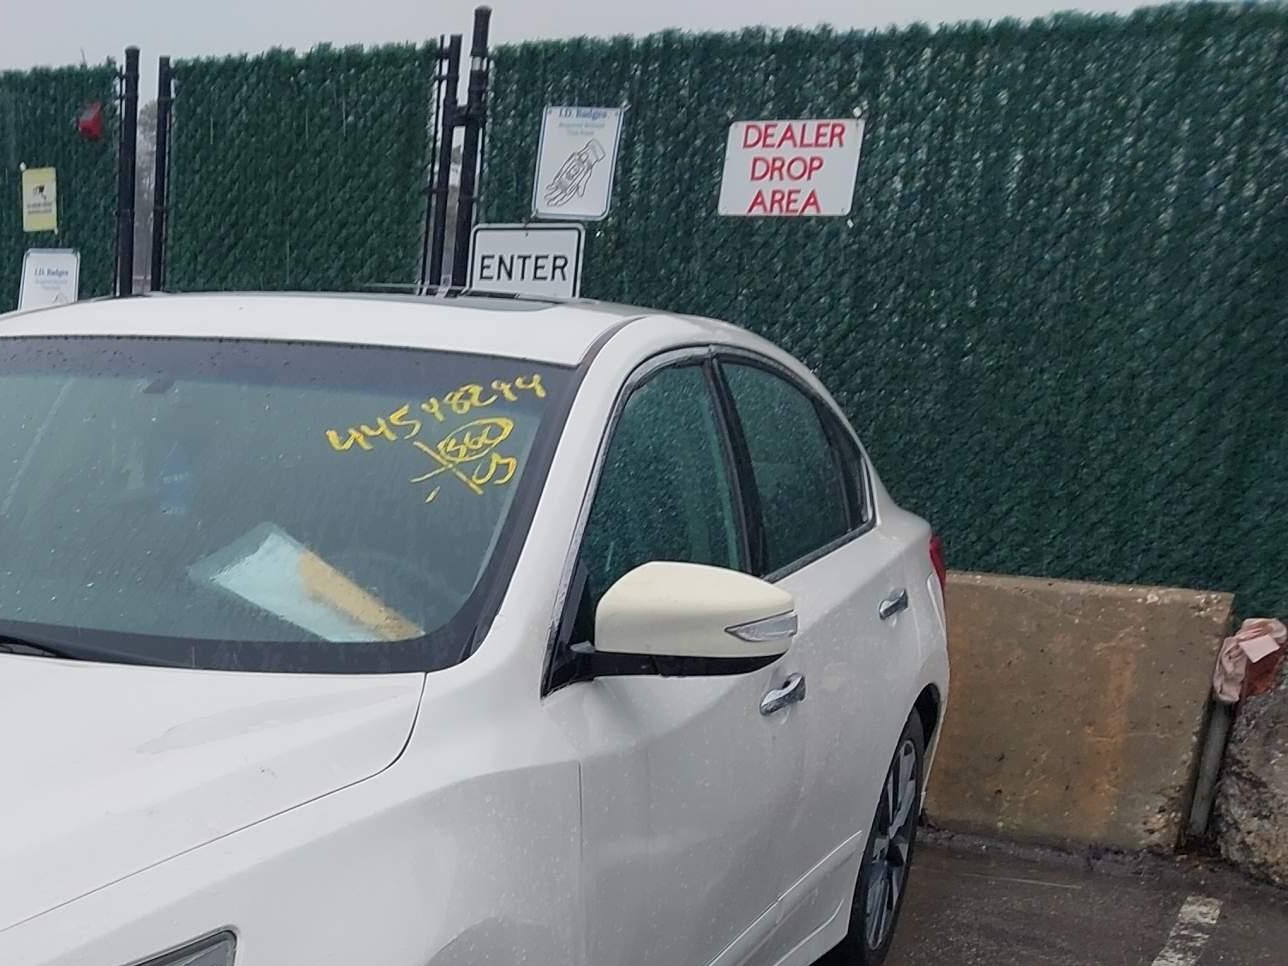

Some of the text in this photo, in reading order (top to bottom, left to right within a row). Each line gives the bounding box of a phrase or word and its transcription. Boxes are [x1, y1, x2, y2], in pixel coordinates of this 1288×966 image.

[742, 122, 846, 148] DEALER
[750, 156, 824, 181] DROP
[747, 189, 821, 214] AREA
[479, 254, 569, 281] ENTER
